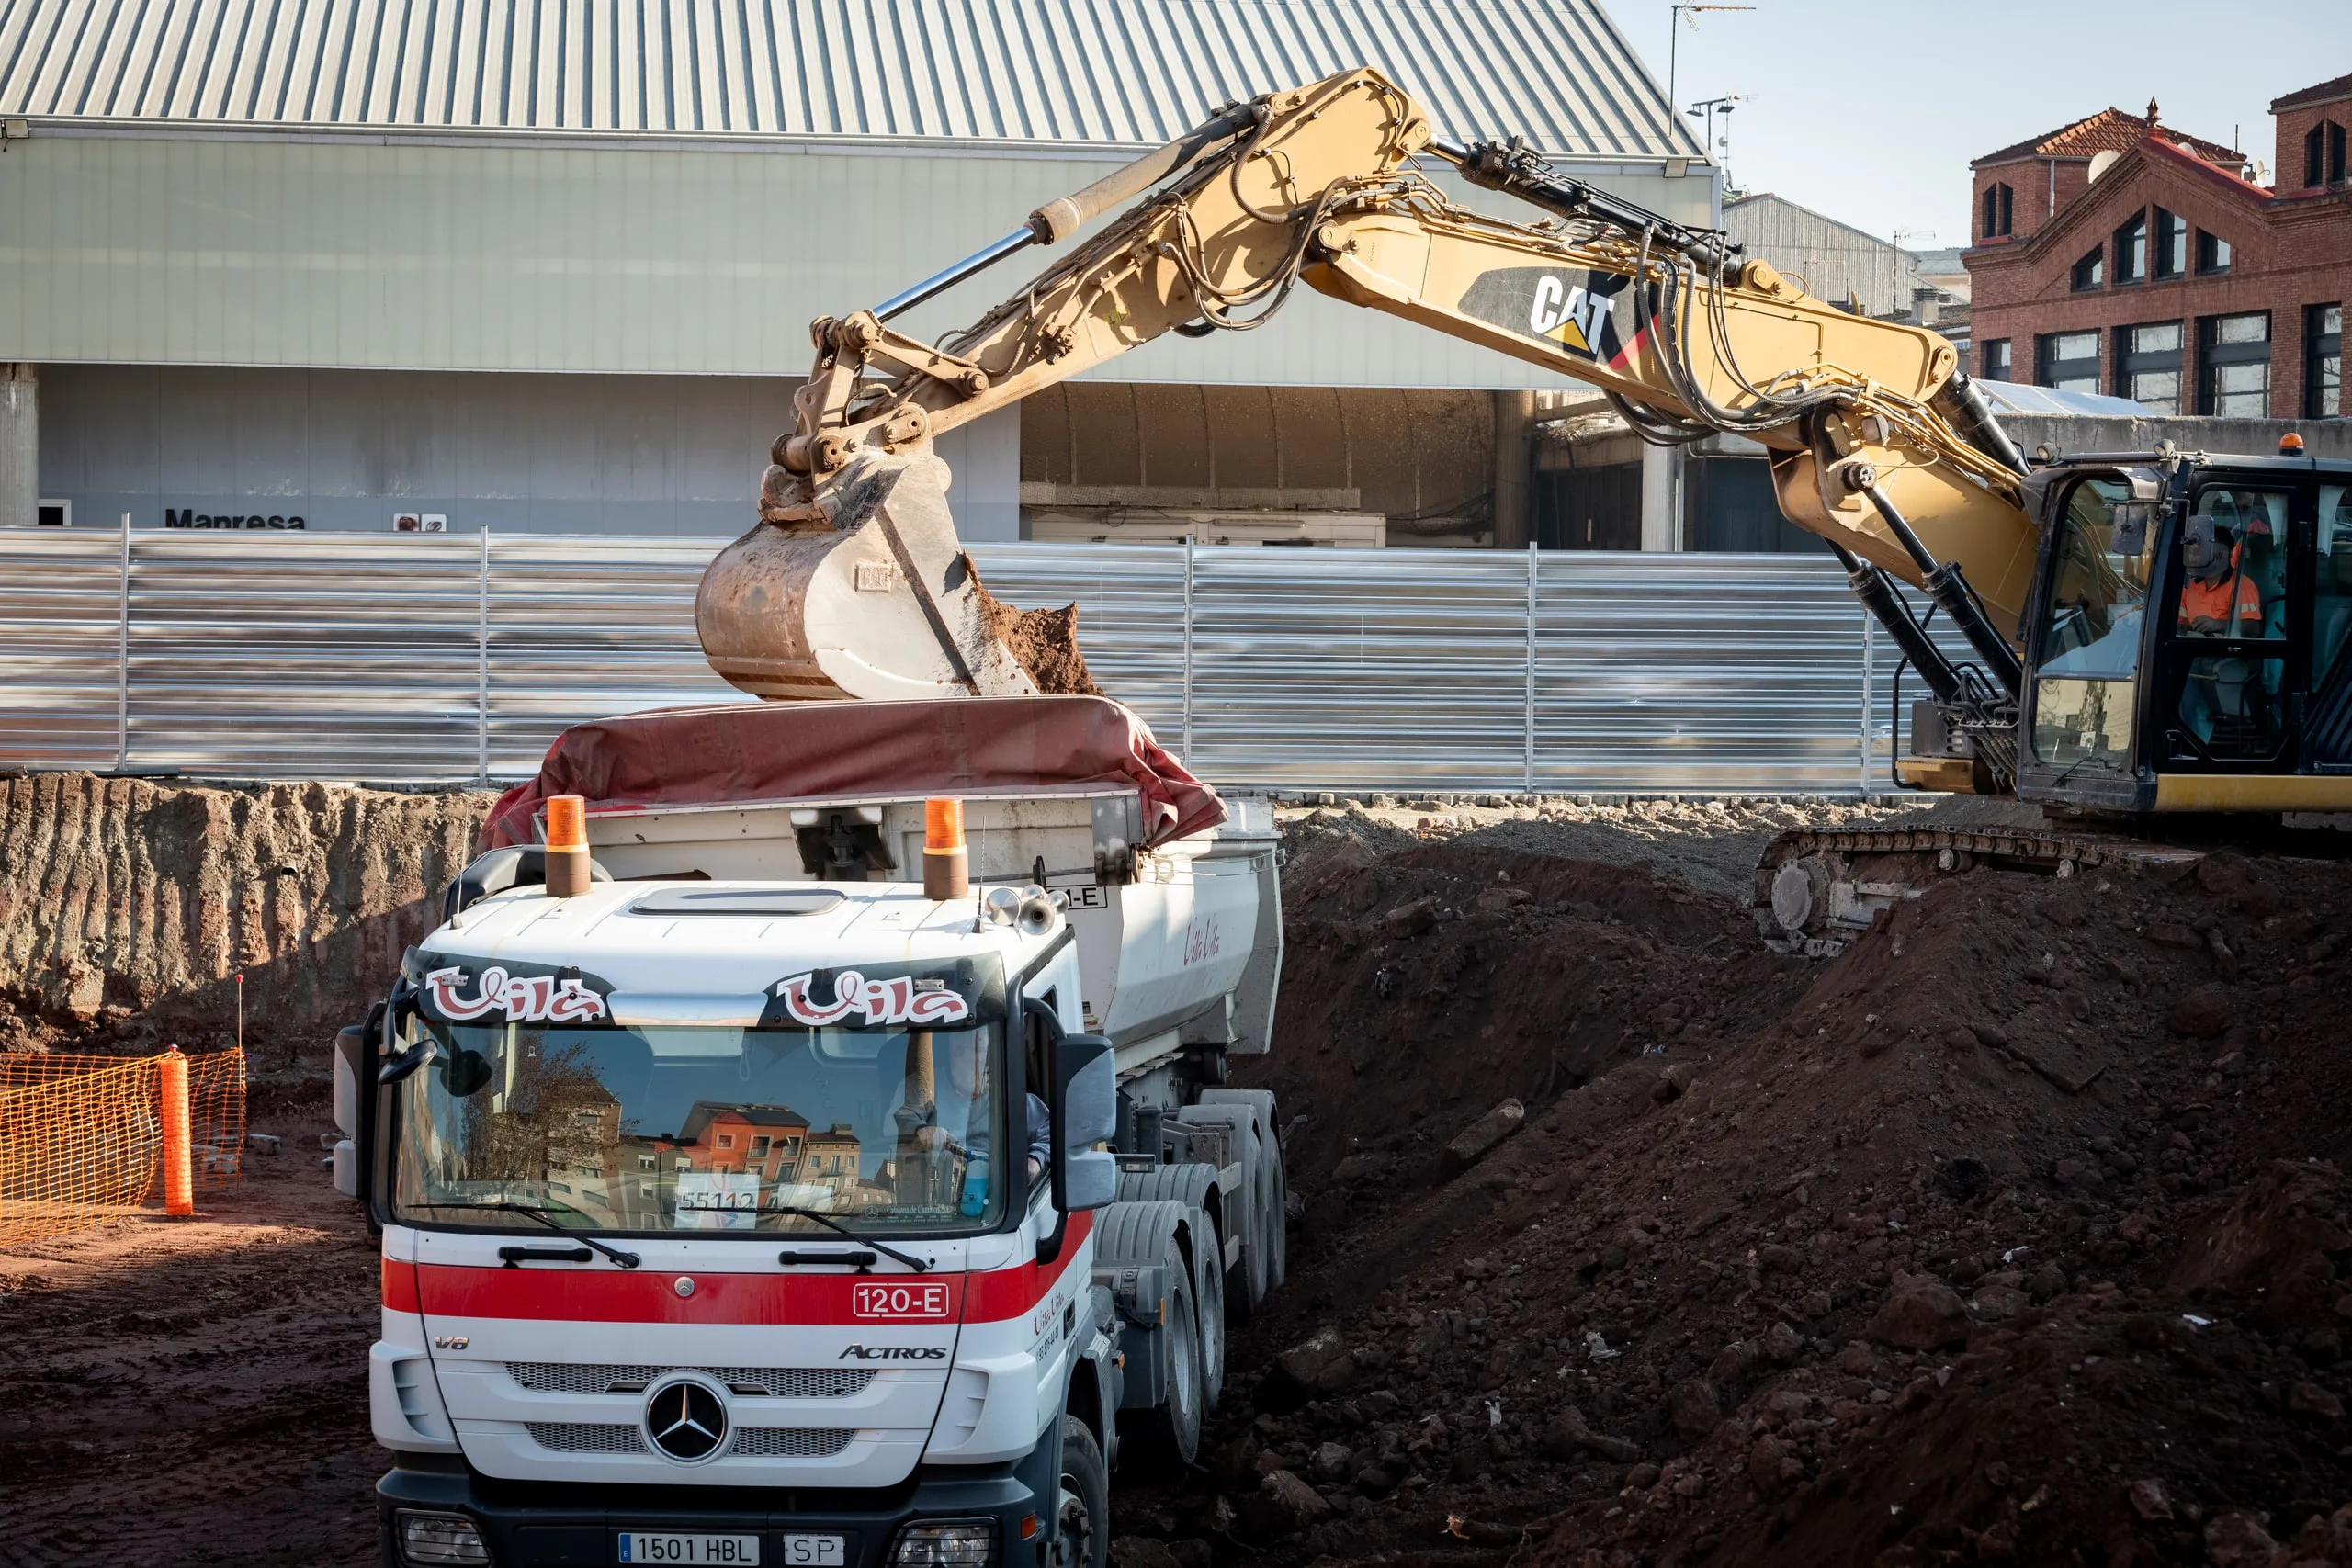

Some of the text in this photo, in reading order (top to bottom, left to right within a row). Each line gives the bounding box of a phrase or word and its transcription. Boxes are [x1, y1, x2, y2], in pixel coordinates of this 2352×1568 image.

[1531, 275, 1615, 355] CAT
[165, 508, 305, 529] Manresa
[858, 1288, 942, 1313] 120-E
[639, 1537, 752, 1562] 1501 HBL
